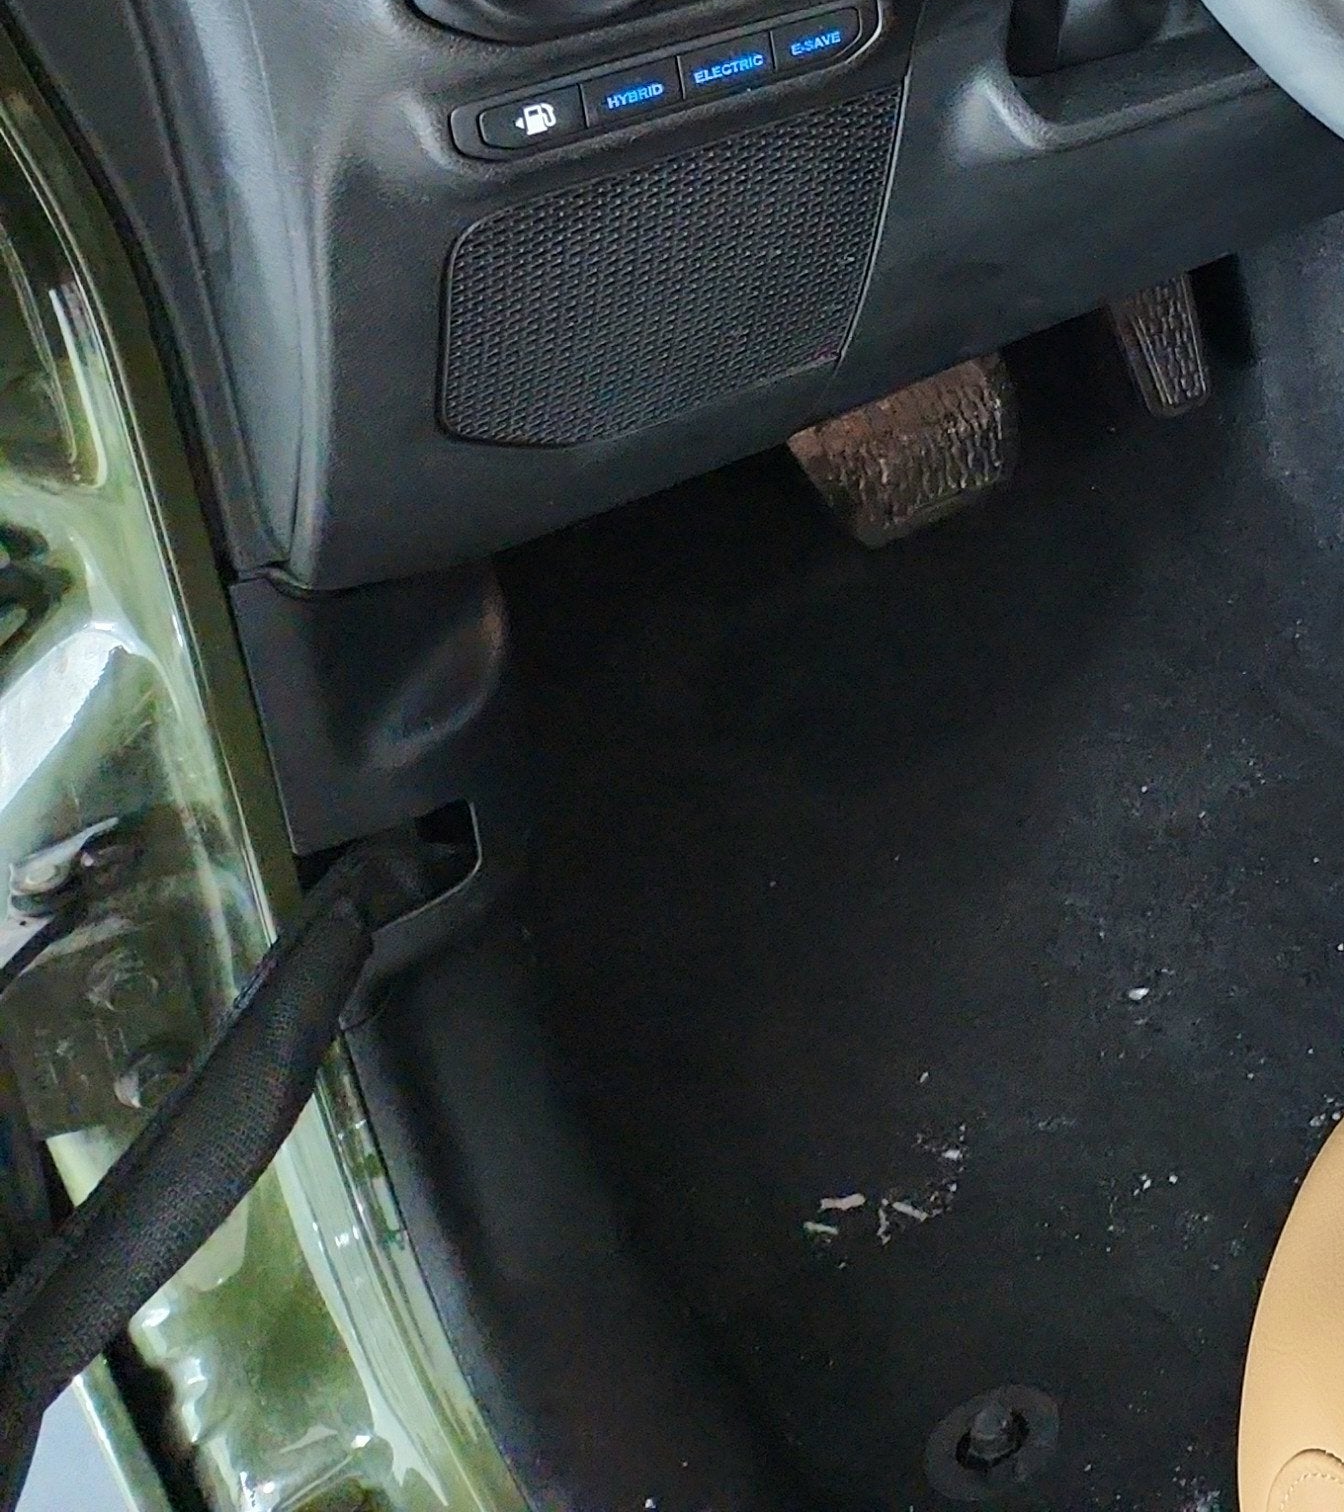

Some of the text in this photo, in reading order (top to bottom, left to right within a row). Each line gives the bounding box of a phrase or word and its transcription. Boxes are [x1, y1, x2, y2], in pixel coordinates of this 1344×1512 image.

[790, 30, 842, 56] E-SAVE
[693, 53, 764, 84] ELECTRIC
[606, 82, 665, 110] HYBRID
